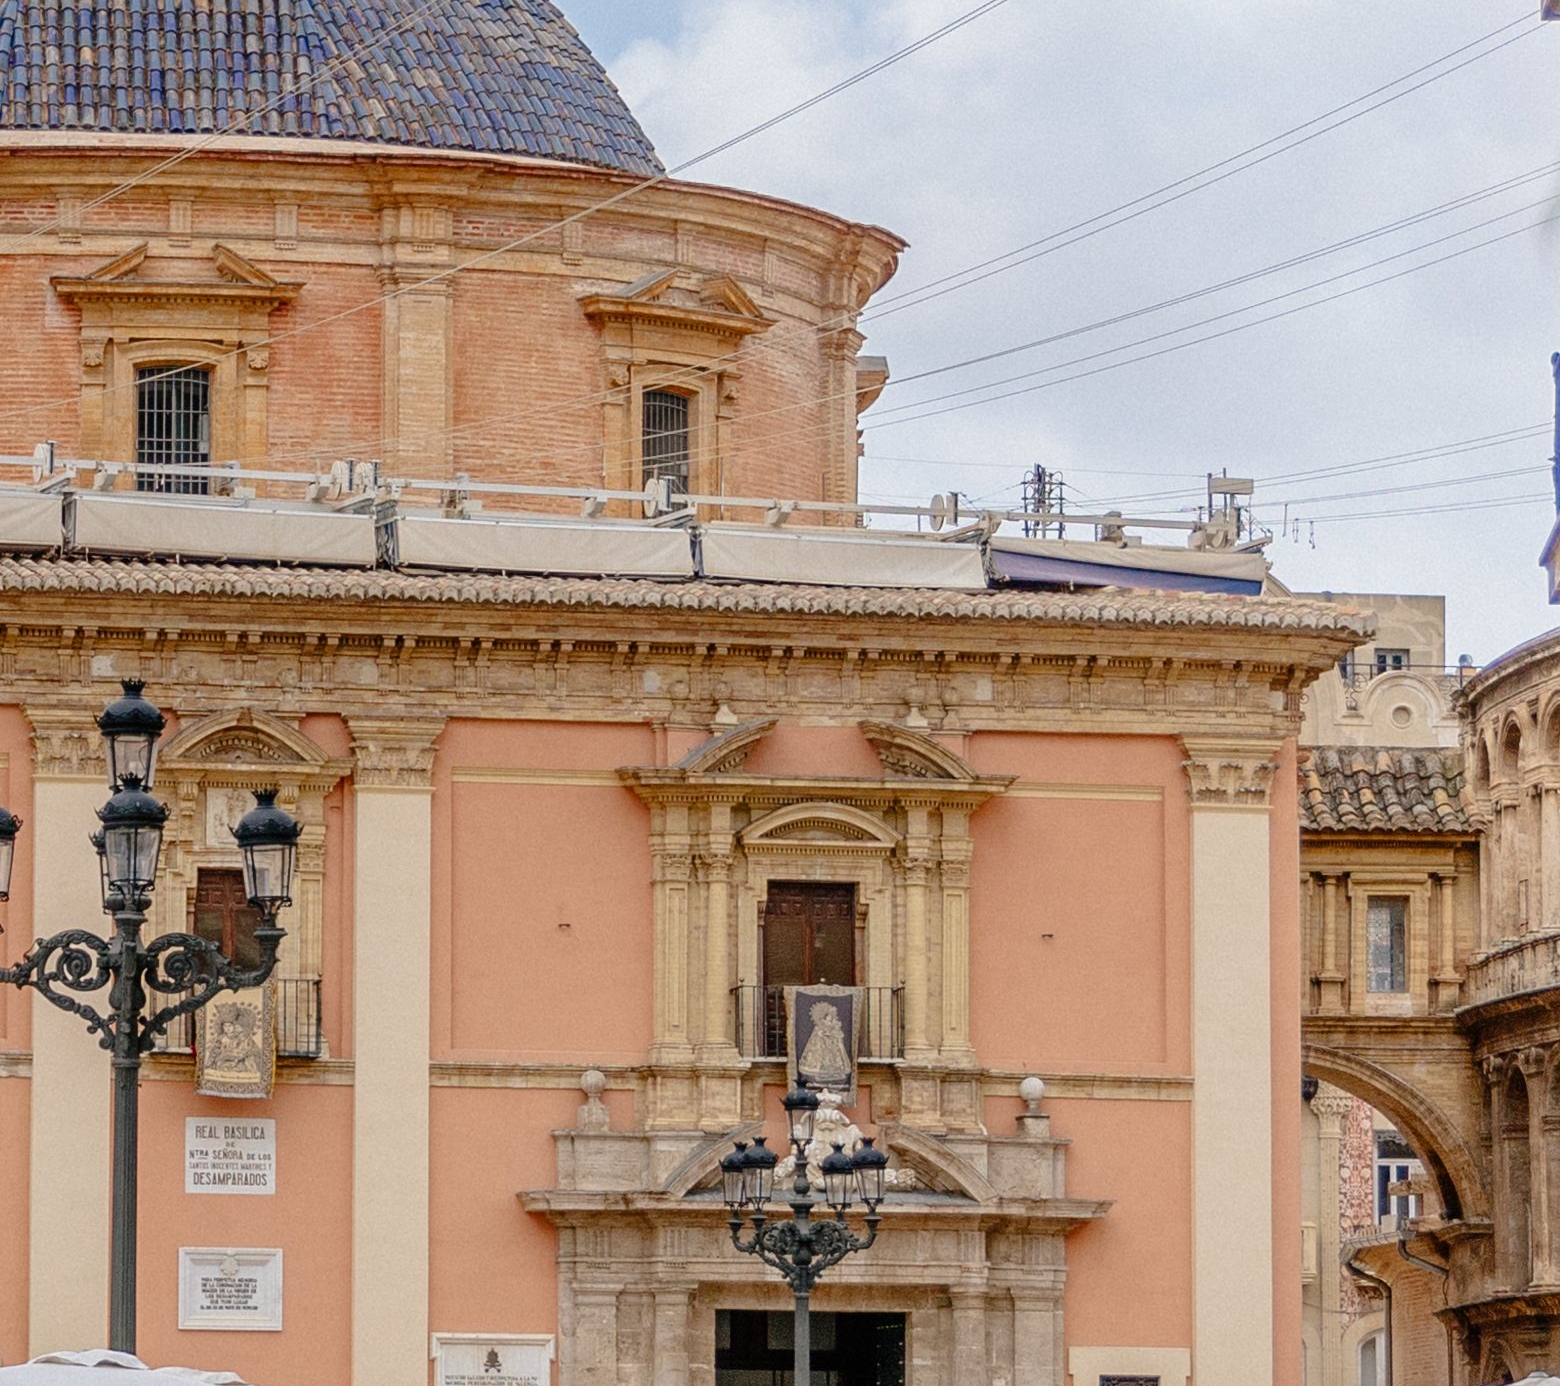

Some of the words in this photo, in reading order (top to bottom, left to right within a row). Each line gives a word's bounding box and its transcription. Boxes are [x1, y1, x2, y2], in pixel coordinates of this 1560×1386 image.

[195, 1125, 220, 1139] REAL
[224, 1125, 265, 1140] BASILICA
[212, 1147, 243, 1161] SEÑORA
[246, 1153, 255, 1161] DE
[258, 1153, 271, 1161] LOS
[193, 1172, 267, 1186] DESAMPARADOS
